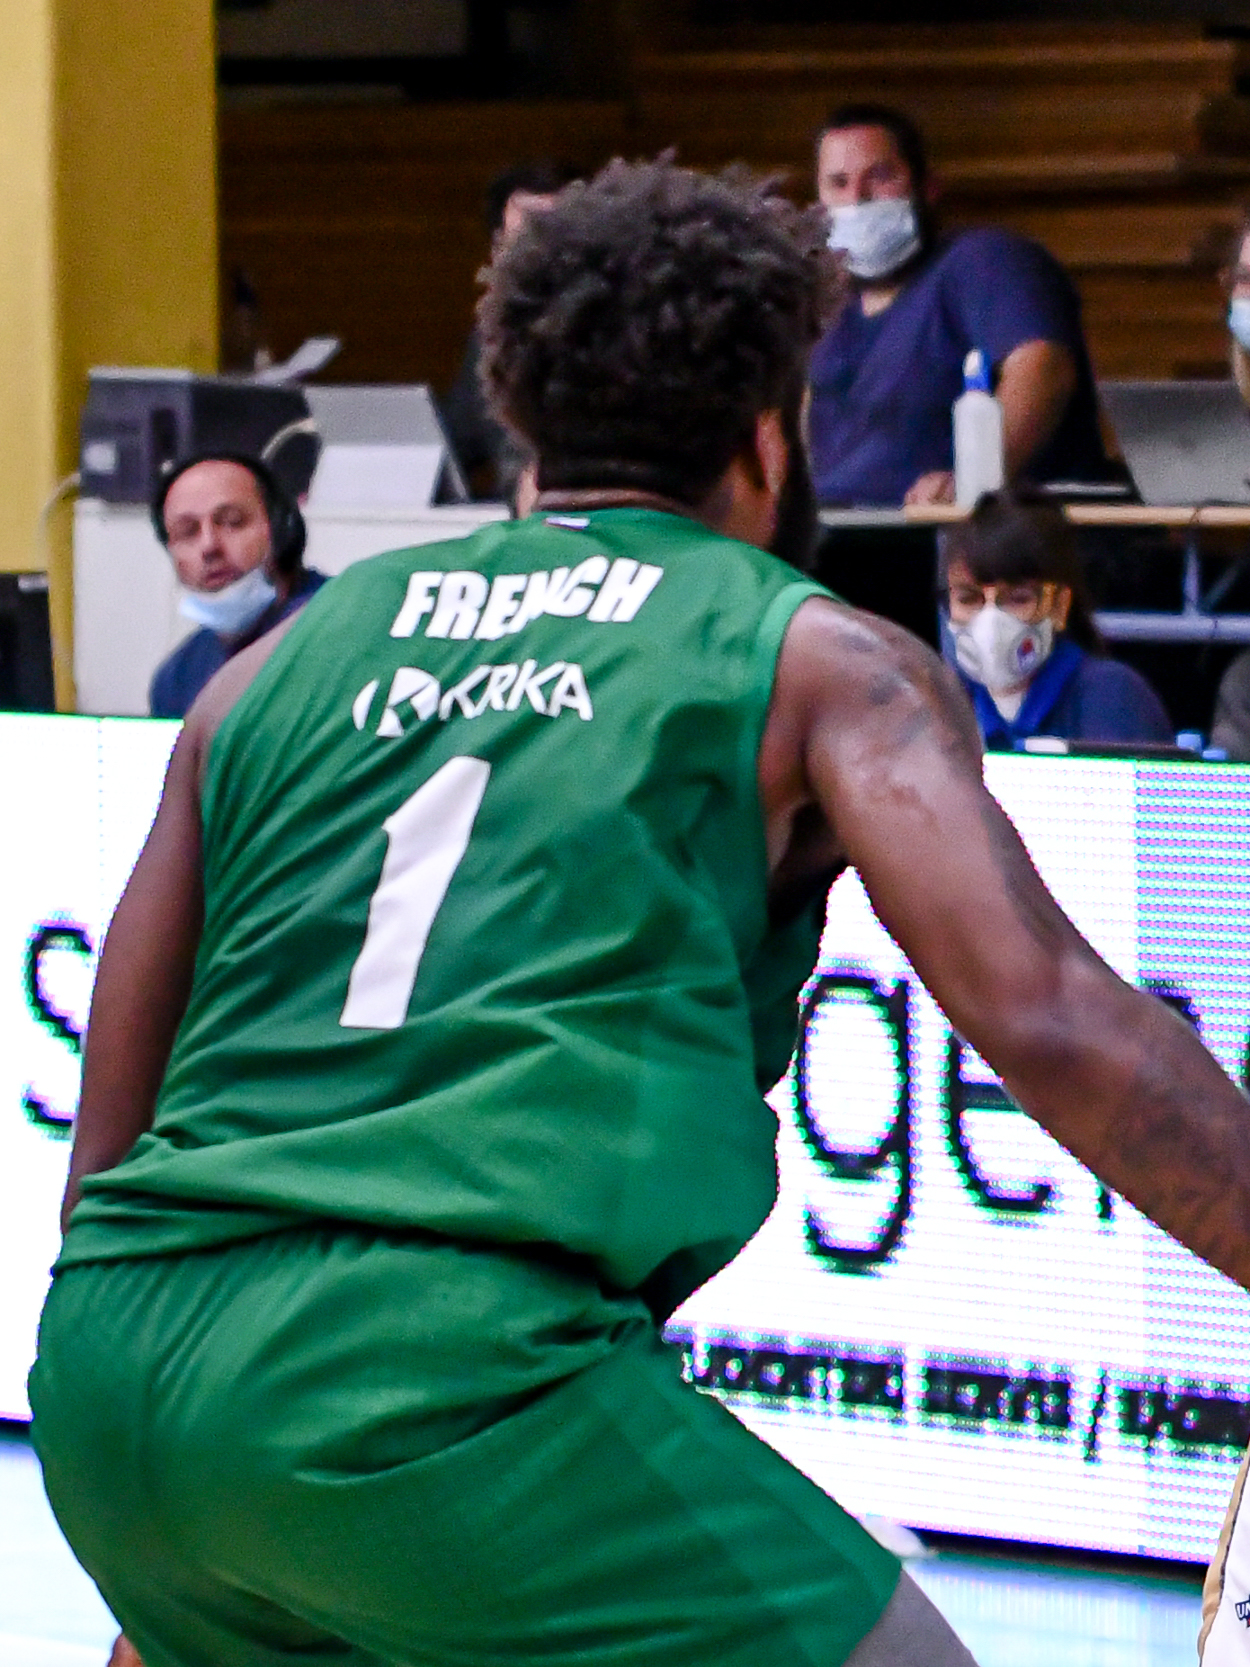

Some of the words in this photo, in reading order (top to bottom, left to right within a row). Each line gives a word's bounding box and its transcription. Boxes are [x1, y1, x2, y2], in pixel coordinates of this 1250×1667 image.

[389, 555, 664, 640] FRENCH
[439, 659, 594, 721] KRKA
[339, 755, 491, 1030] 1
